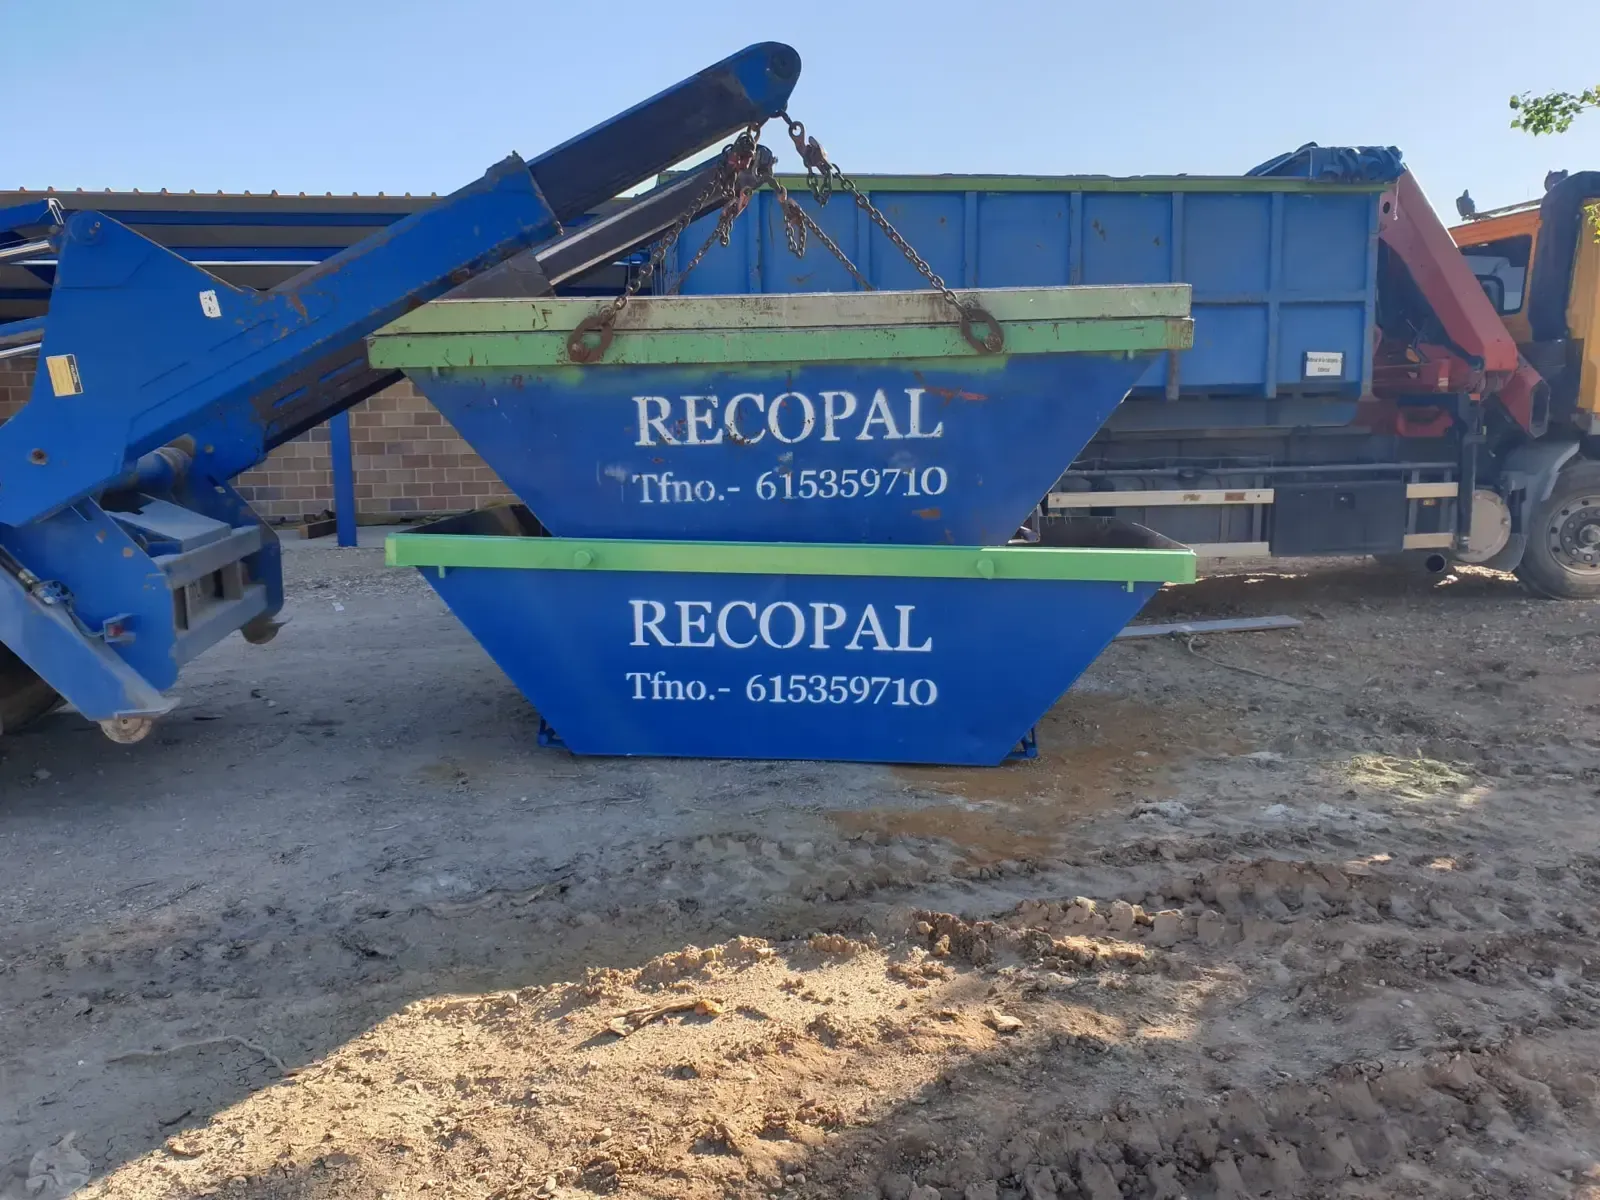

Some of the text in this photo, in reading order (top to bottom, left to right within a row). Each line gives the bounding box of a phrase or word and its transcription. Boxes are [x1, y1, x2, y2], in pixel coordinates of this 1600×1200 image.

[632, 388, 943, 446] RECOPAL
[632, 466, 948, 504] Tfno.- 615359710
[628, 599, 932, 652] RECOPAL
[625, 671, 938, 706] Tfno.- 615359710
